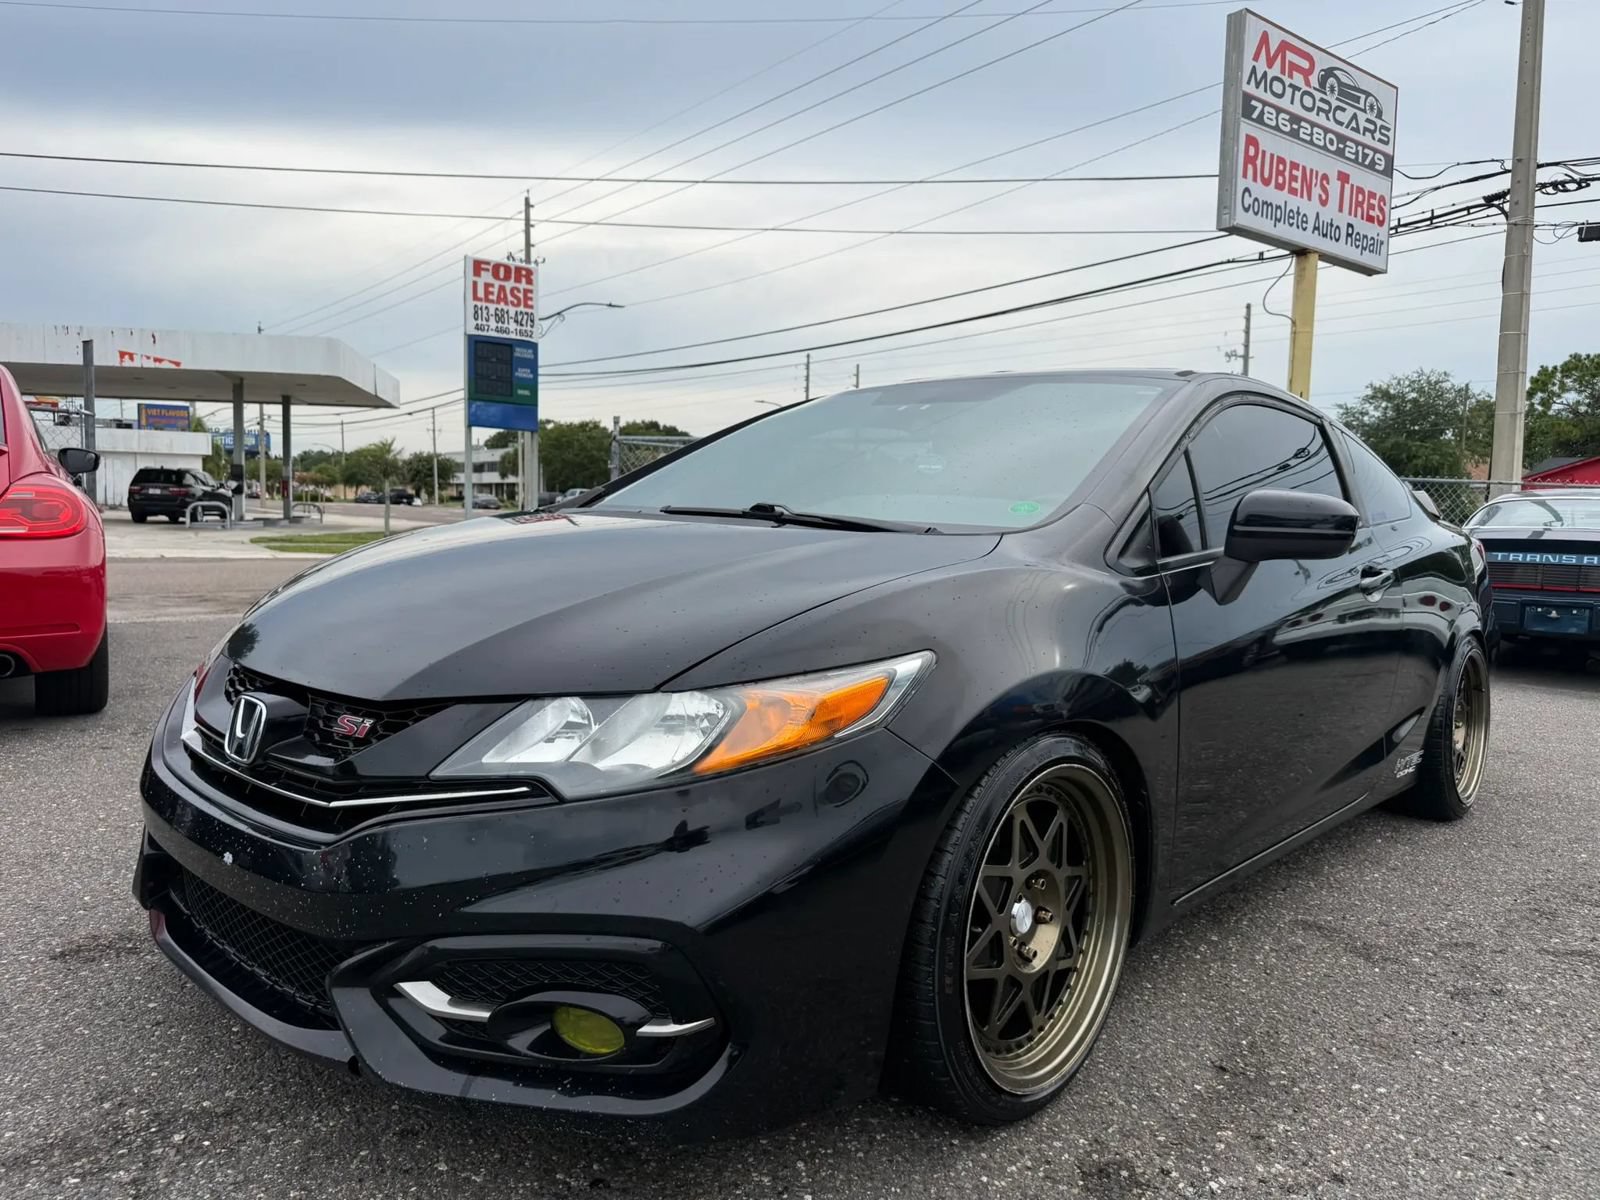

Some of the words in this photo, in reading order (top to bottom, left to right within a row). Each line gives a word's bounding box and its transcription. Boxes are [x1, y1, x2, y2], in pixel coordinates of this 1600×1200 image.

[1252, 30, 1316, 89] MR
[1246, 65, 1391, 146] MOTORCARS
[1249, 101, 1386, 171] 786-280-2179
[1241, 133, 1330, 208] RUBEN'S
[1336, 169, 1387, 229] TIRES
[1241, 187, 1308, 232] Complete
[1312, 214, 1342, 243] Auto
[1345, 223, 1384, 257] Repair
[472, 259, 534, 286] FOR
[472, 280, 534, 310] LEASE
[473, 304, 535, 329] 813-681-4279
[1491, 552, 1577, 564] TRANS
[333, 714, 374, 738] Si
